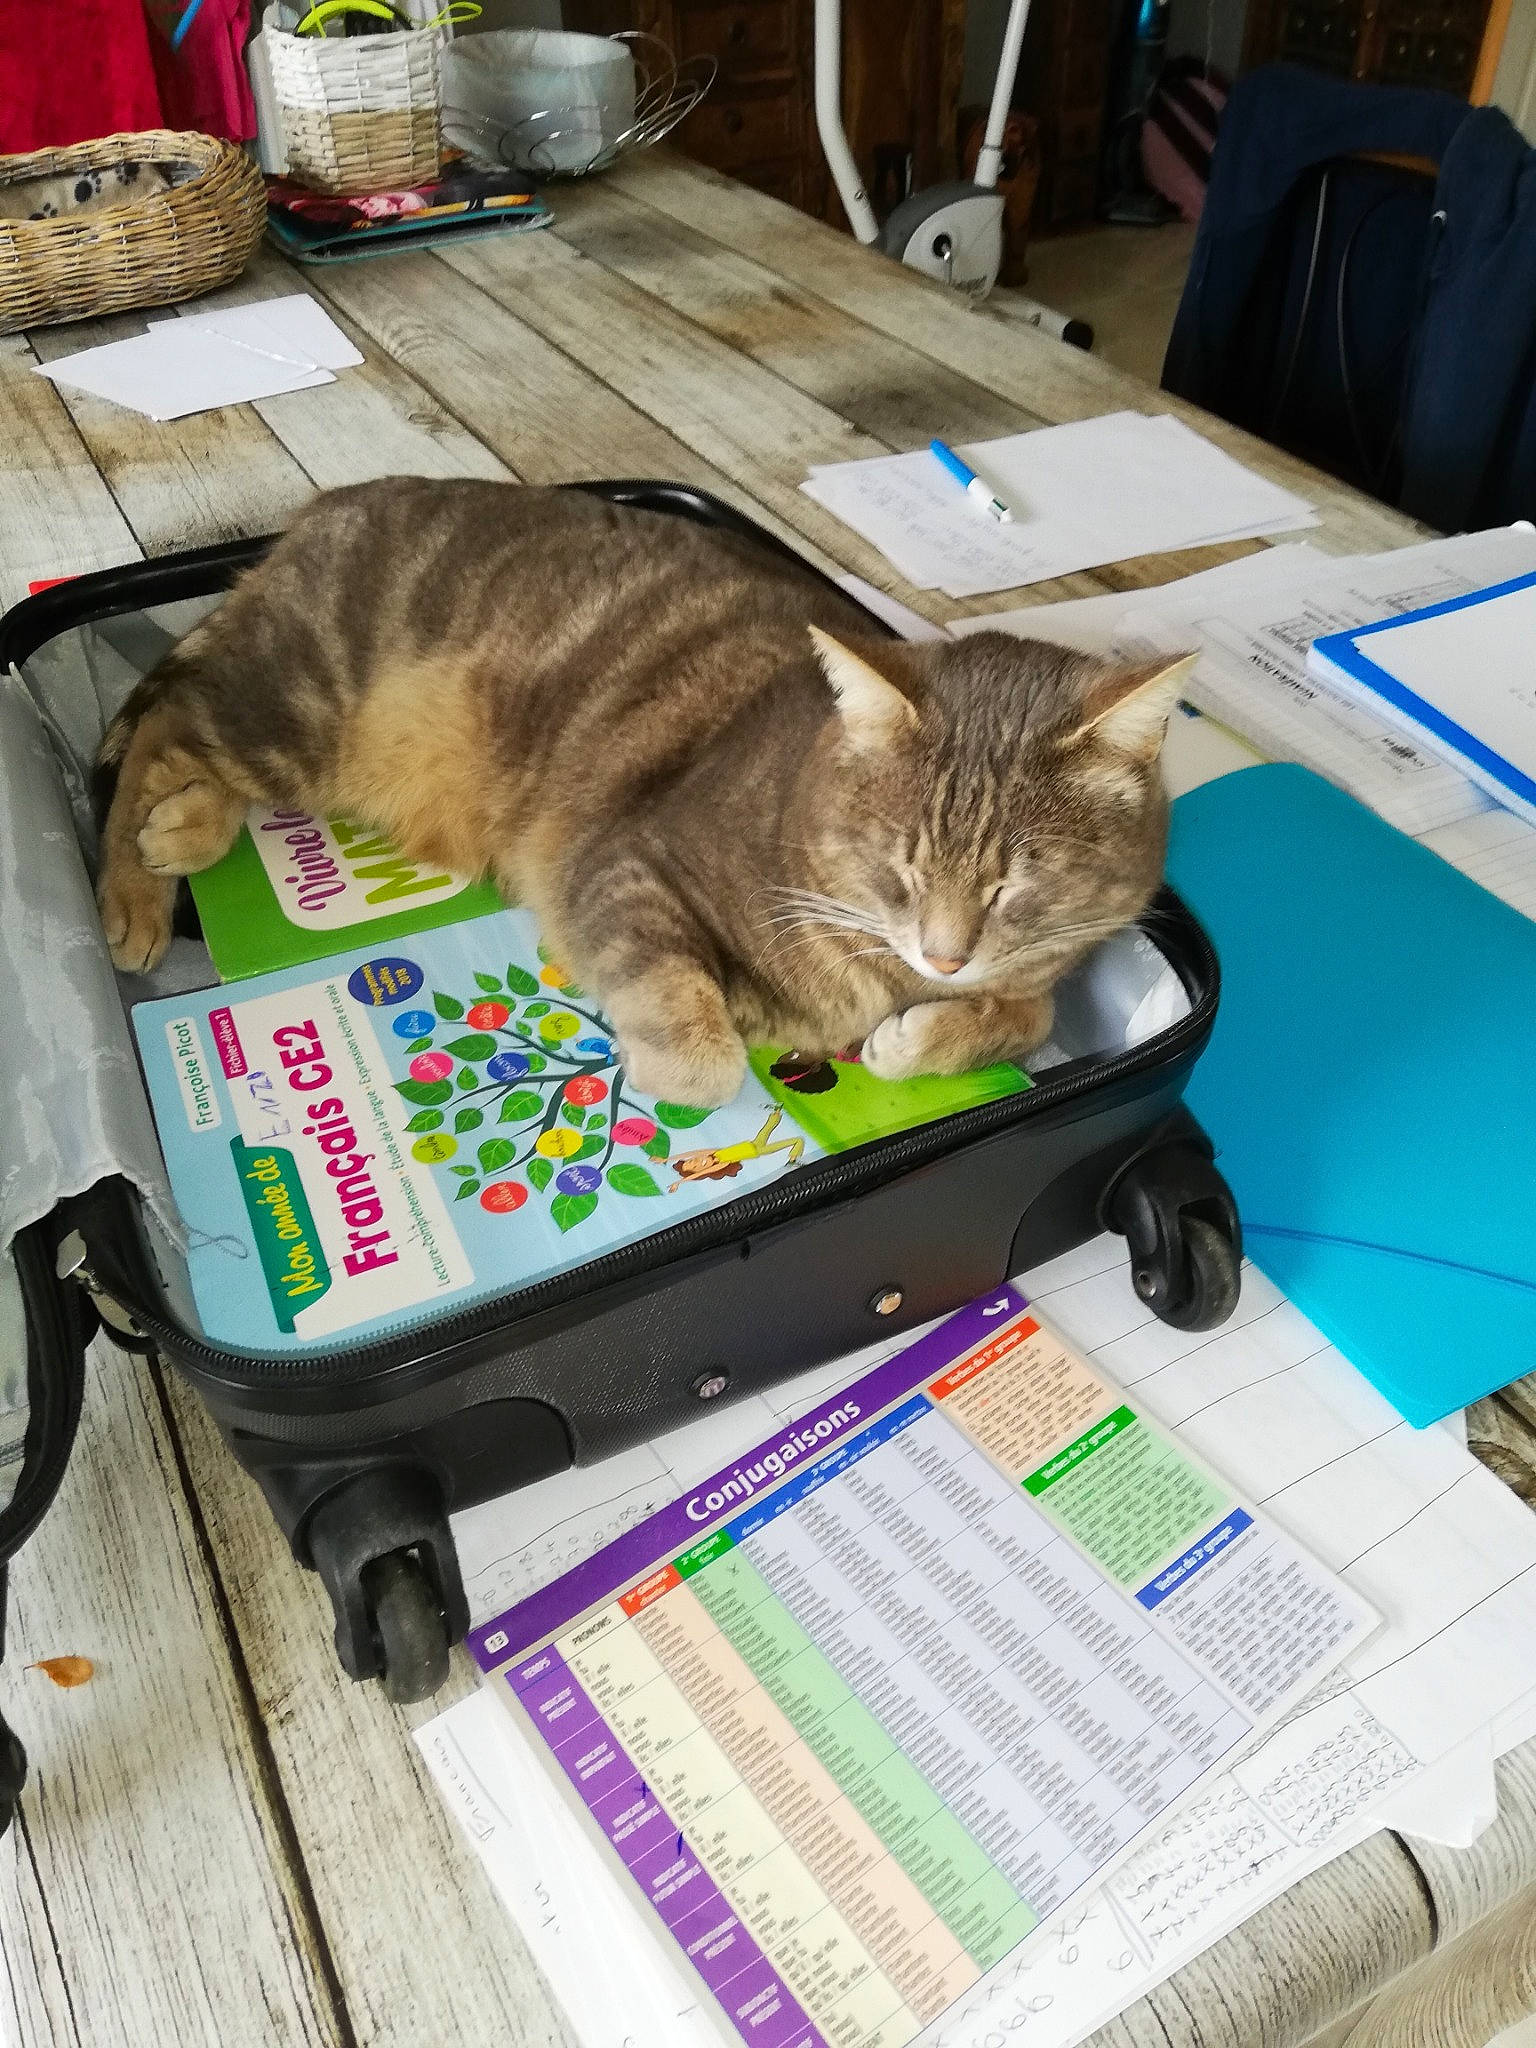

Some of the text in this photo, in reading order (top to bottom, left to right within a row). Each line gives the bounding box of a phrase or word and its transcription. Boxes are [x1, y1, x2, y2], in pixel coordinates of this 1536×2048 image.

[285, 828, 347, 910] Vivre
[325, 983, 340, 1004] orale
[336, 1014, 353, 1039] écrite
[219, 1018, 244, 1075] Fichier-élève
[345, 1038, 370, 1084] Expression
[173, 1022, 216, 1126] Françoise Picot
[366, 1089, 386, 1120] langue
[376, 1121, 388, 1131] la
[381, 1132, 393, 1142] de
[272, 1019, 399, 1278] Français CE2
[384, 1143, 403, 1170] Étude
[245, 1155, 324, 1297] Mon année de
[400, 1176, 450, 1287] Lecture-compréhension
[994, 1331, 1022, 1354] groupe
[1088, 1421, 1117, 1446] groupe
[686, 1400, 861, 1521] Conjugaisons
[1154, 1565, 1186, 1591] Verbes
[1203, 1526, 1234, 1554] groupe
[490, 1635, 504, 1648] 13
[572, 1616, 612, 1645] PRONOMS
